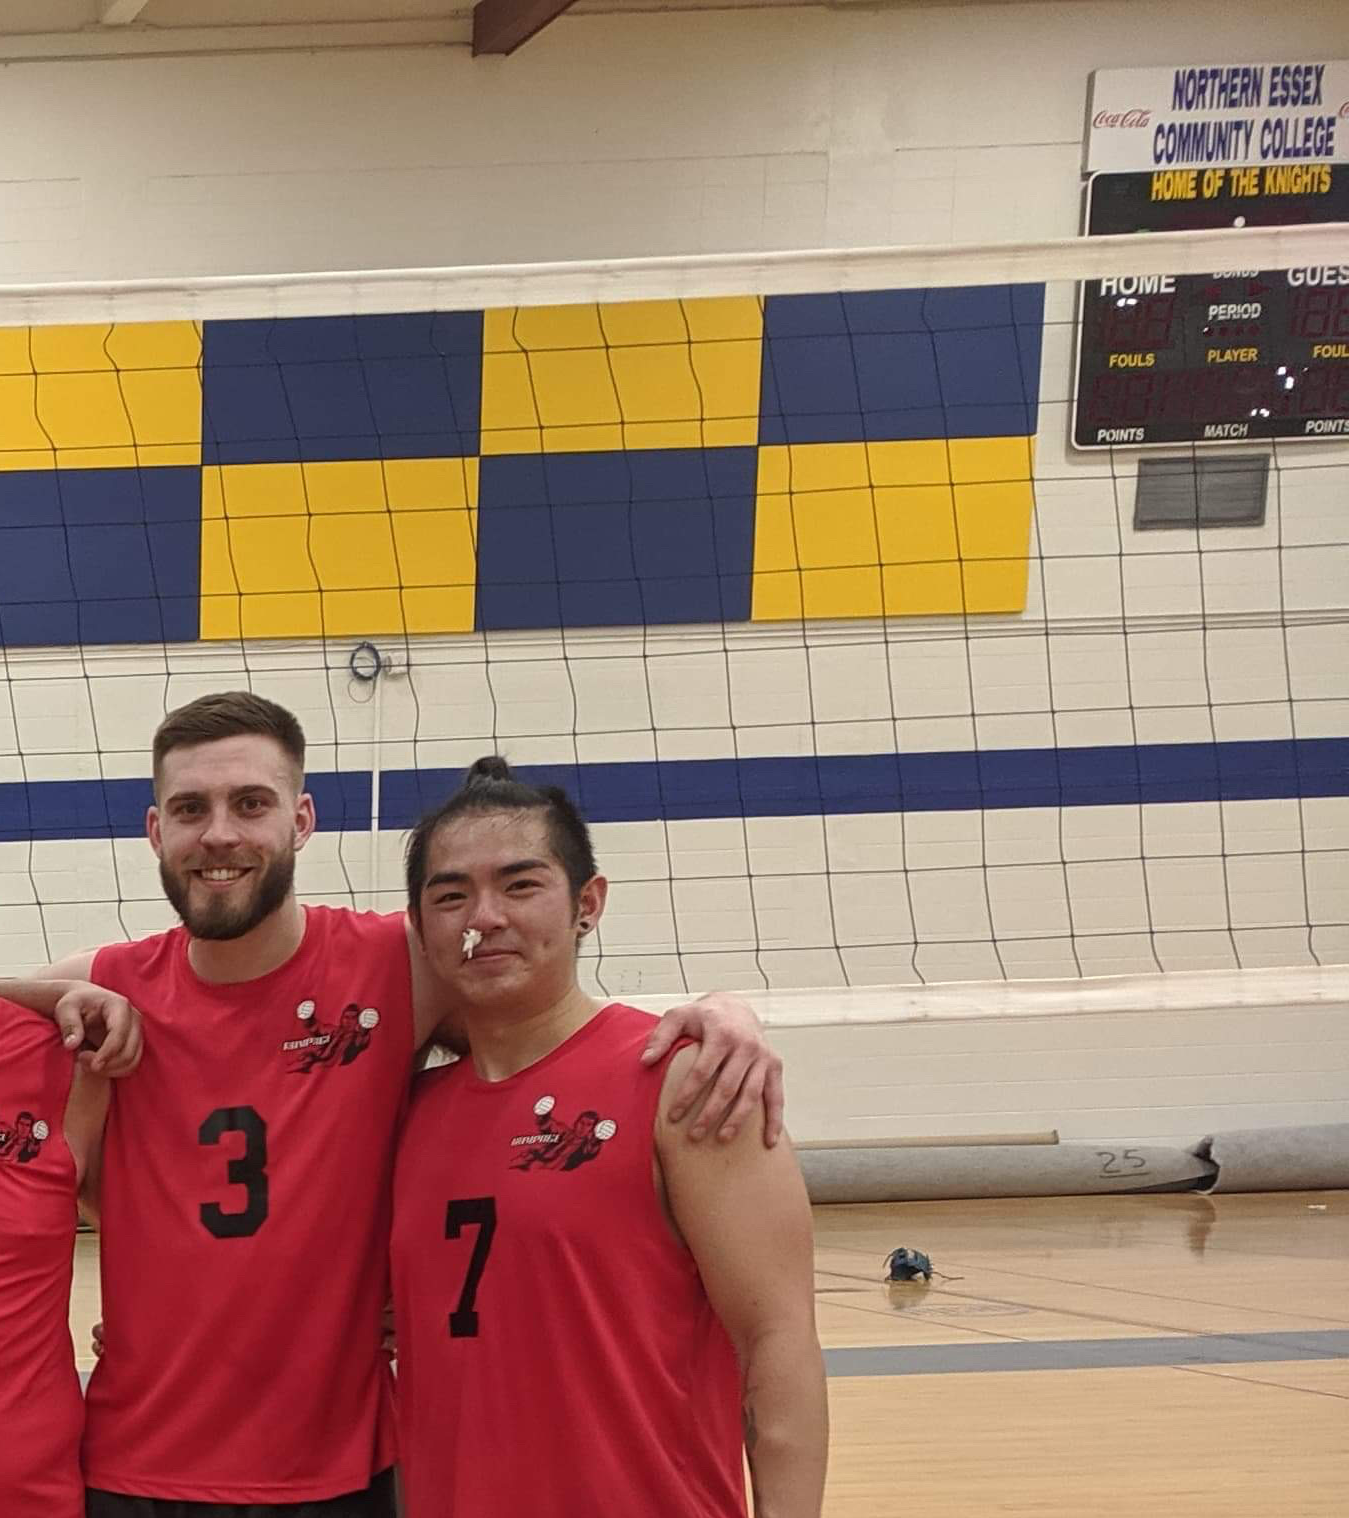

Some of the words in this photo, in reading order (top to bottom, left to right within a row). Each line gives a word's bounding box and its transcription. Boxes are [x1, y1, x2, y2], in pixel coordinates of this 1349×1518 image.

[1171, 67, 1264, 111] NORTHERN
[1268, 64, 1326, 107] ESSEX
[1153, 119, 1255, 164] COMMUNITY
[1260, 116, 1337, 159] COLLEGE
[1151, 169, 1199, 201] HOME
[1203, 168, 1224, 198] OF
[1230, 166, 1260, 197] THE
[1264, 164, 1333, 195] KNIGHTS
[1100, 274, 1177, 296] HOME
[1208, 302, 1262, 321] PERIOD
[1108, 353, 1156, 368] FOULS
[1206, 347, 1258, 363] PLAYER
[1097, 428, 1145, 442] POINTS
[1204, 423, 1249, 438] MATCH
[197, 1104, 269, 1239] 3
[1095, 1148, 1146, 1174] 25
[444, 1196, 497, 1338] 7
